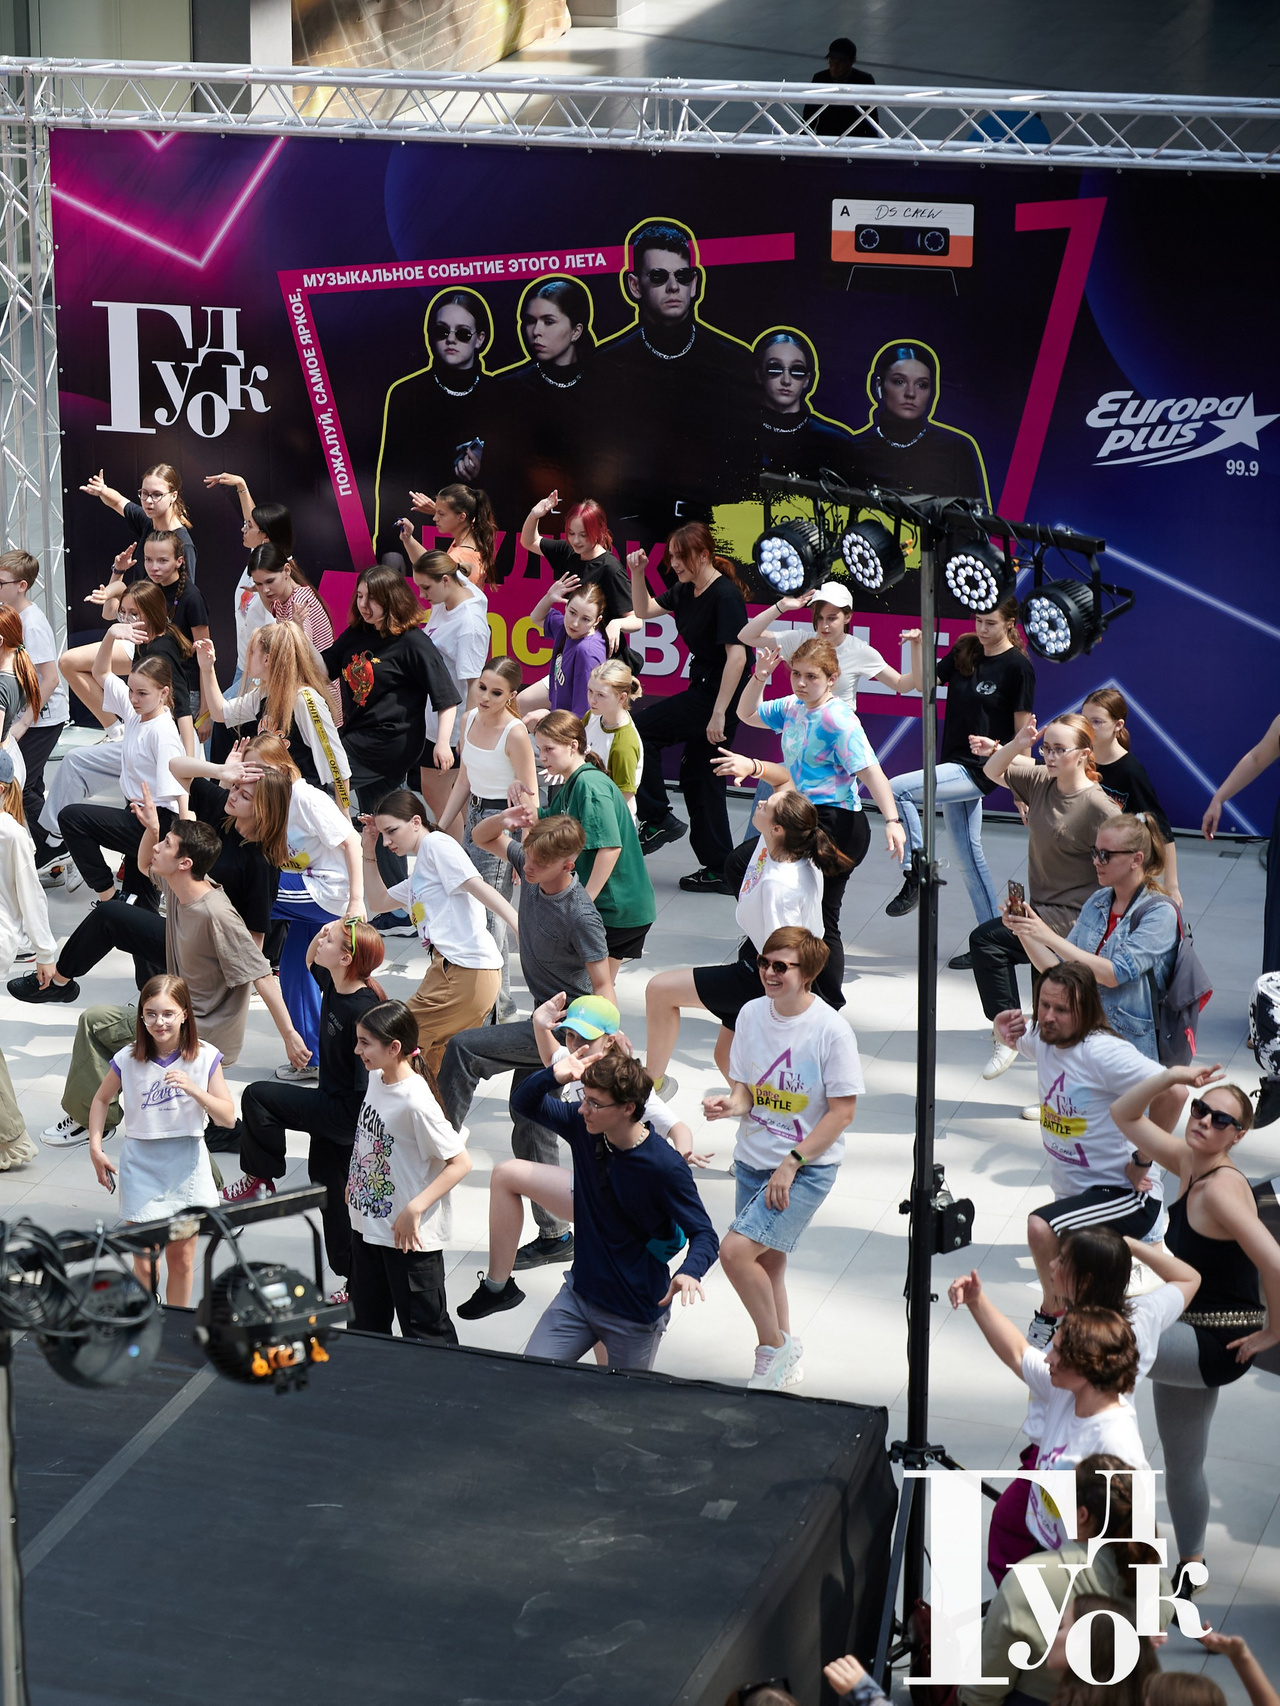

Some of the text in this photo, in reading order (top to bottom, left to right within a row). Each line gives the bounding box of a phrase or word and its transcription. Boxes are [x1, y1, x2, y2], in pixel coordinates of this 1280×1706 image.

[840, 205, 851, 217] A
[875, 204, 943, 221] DS CREW
[302, 252, 607, 288] МУЗЫКАЛЬНОЕ СОБЫТИЕ ЭТОГО ЛЕТА
[288, 287, 353, 496] ПОЖАЛУЙ, САМОЕ ЯРКОЕ,
[1225, 459, 1260, 477] 99.9
